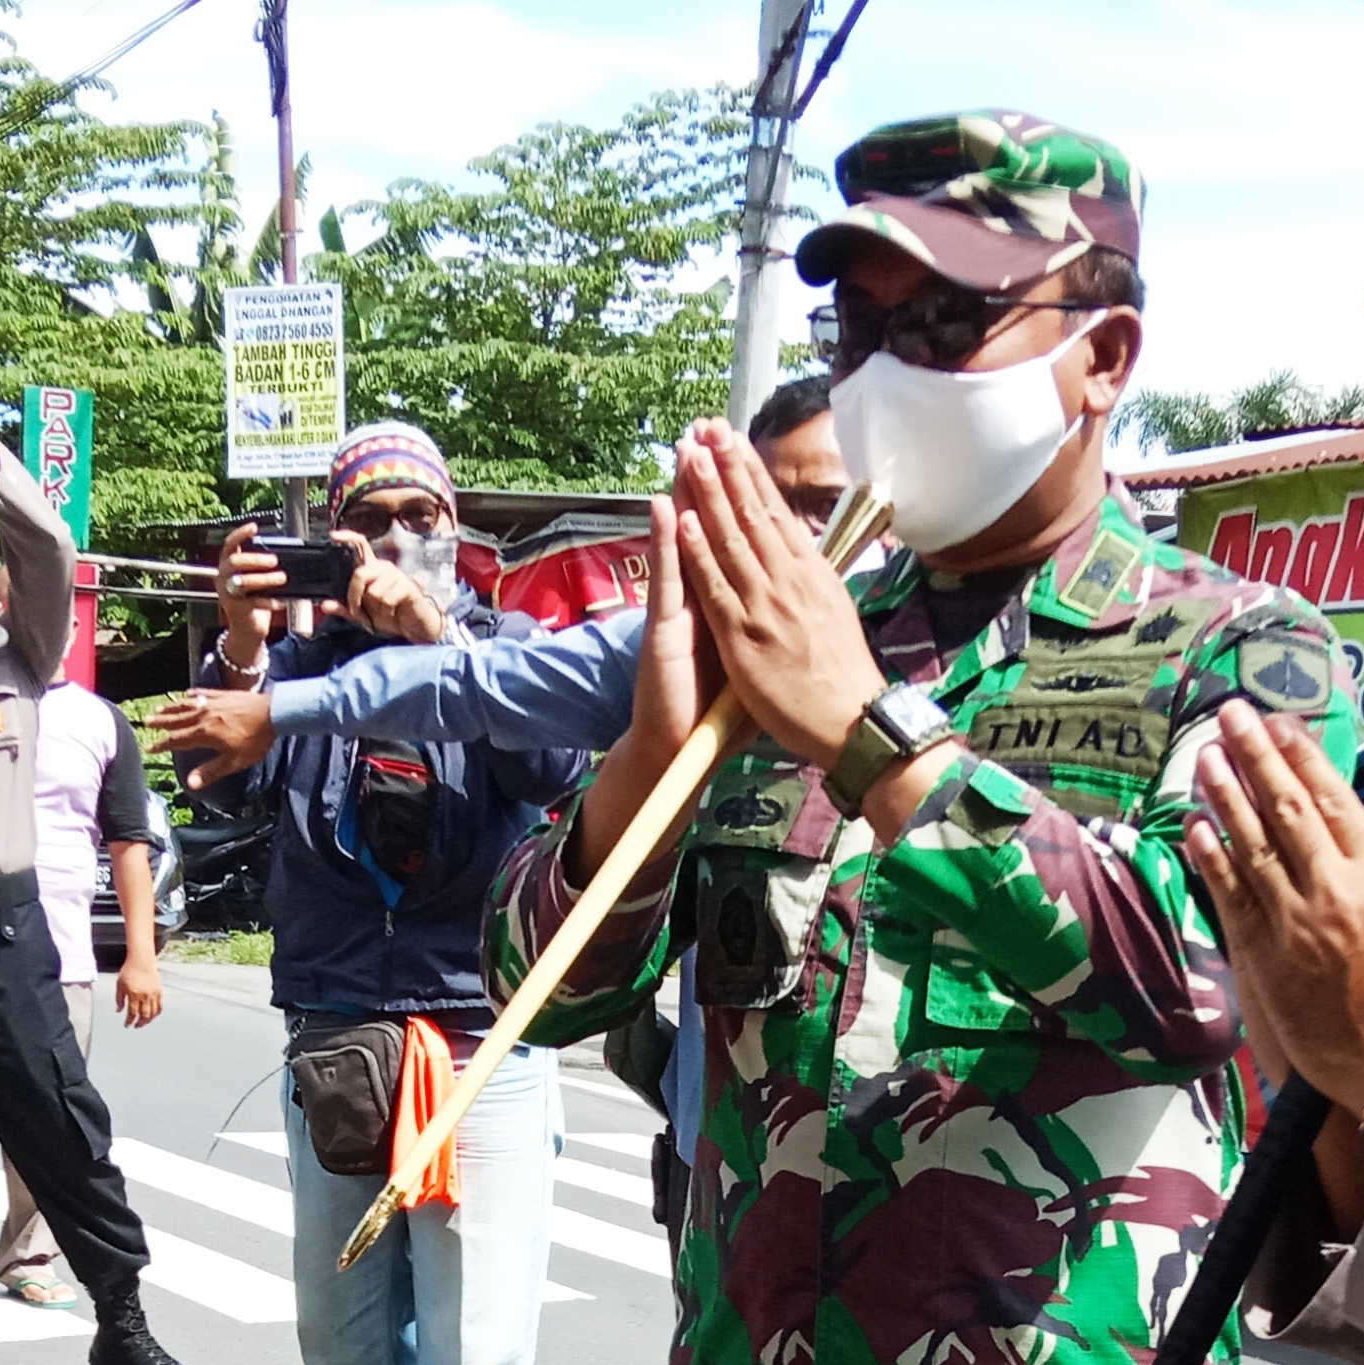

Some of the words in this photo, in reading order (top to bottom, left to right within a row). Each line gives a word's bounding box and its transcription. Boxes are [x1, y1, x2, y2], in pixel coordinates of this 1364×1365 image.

[234, 344, 287, 362] TAMBAH
[292, 341, 337, 360] TINGGI
[235, 361, 284, 382] BADAN
[315, 360, 336, 379] CM
[249, 381, 324, 394] TERBUKTI
[987, 719, 1062, 752] TNI
[1071, 719, 1146, 757] AD
